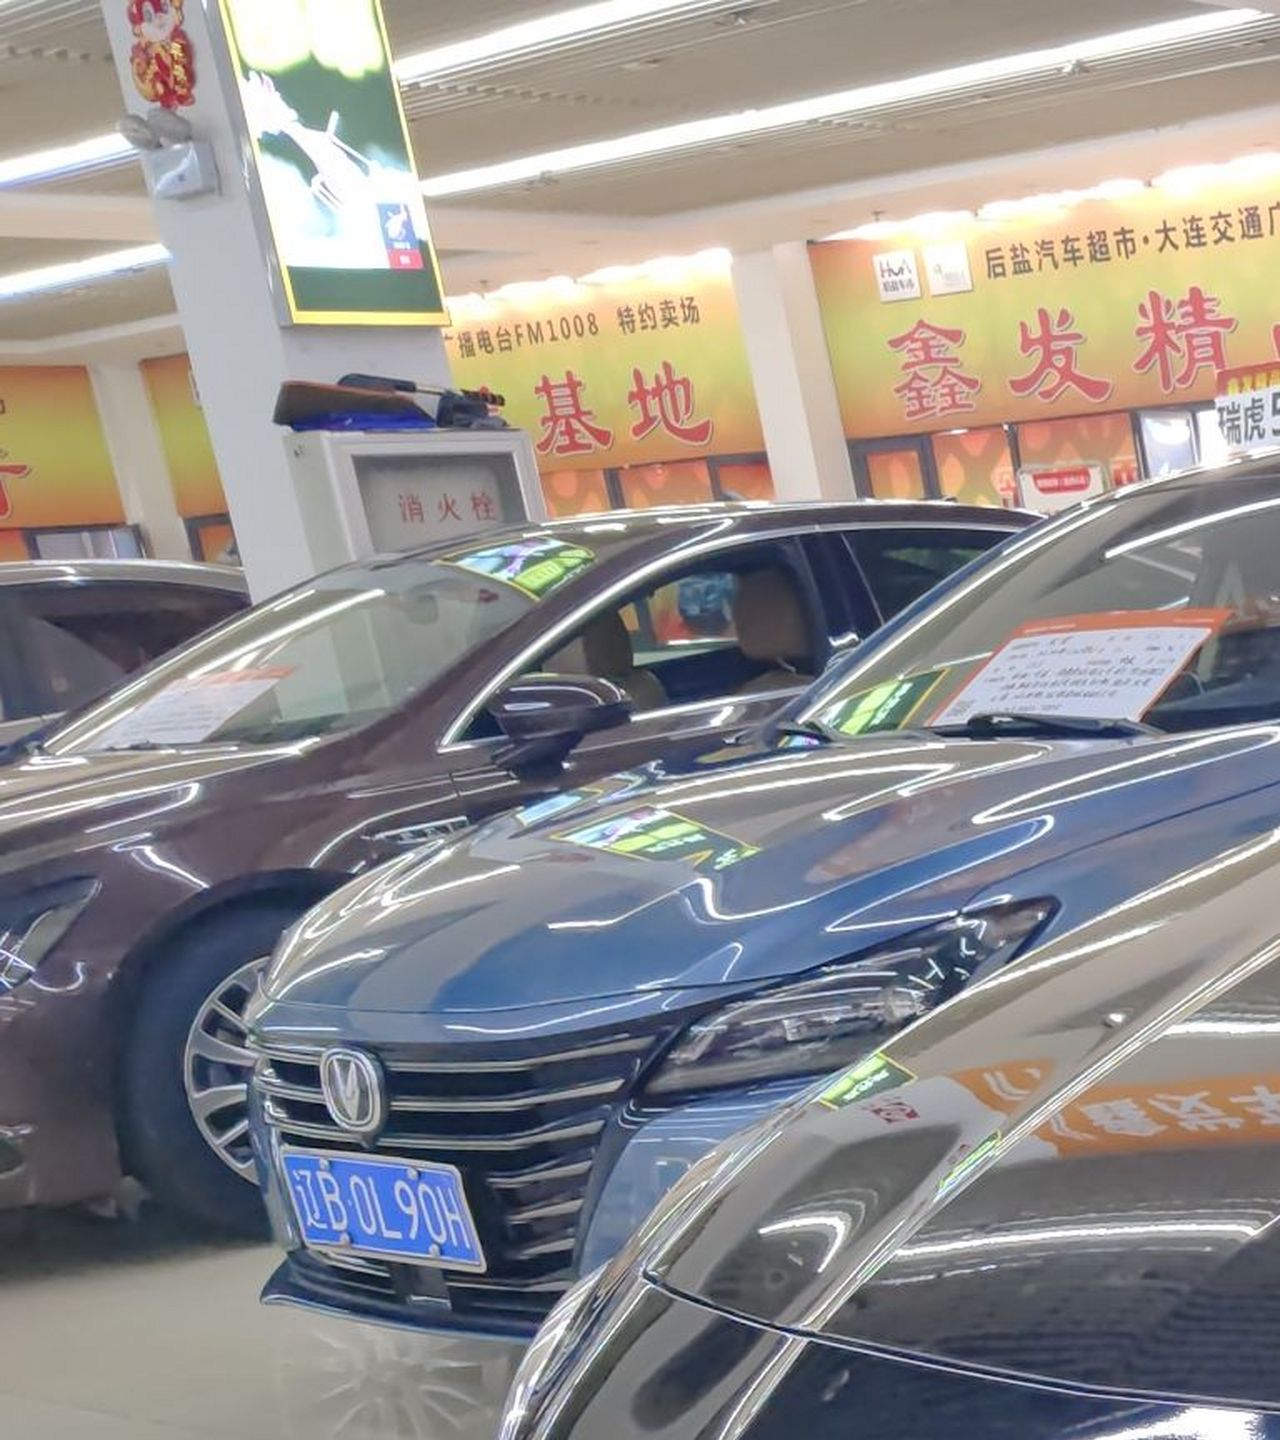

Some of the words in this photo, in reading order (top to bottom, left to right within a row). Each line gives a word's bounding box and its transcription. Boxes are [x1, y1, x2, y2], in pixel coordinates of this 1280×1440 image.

[445, 312, 599, 358] 播电台FM1008
[616, 297, 701, 336] 特约卖场
